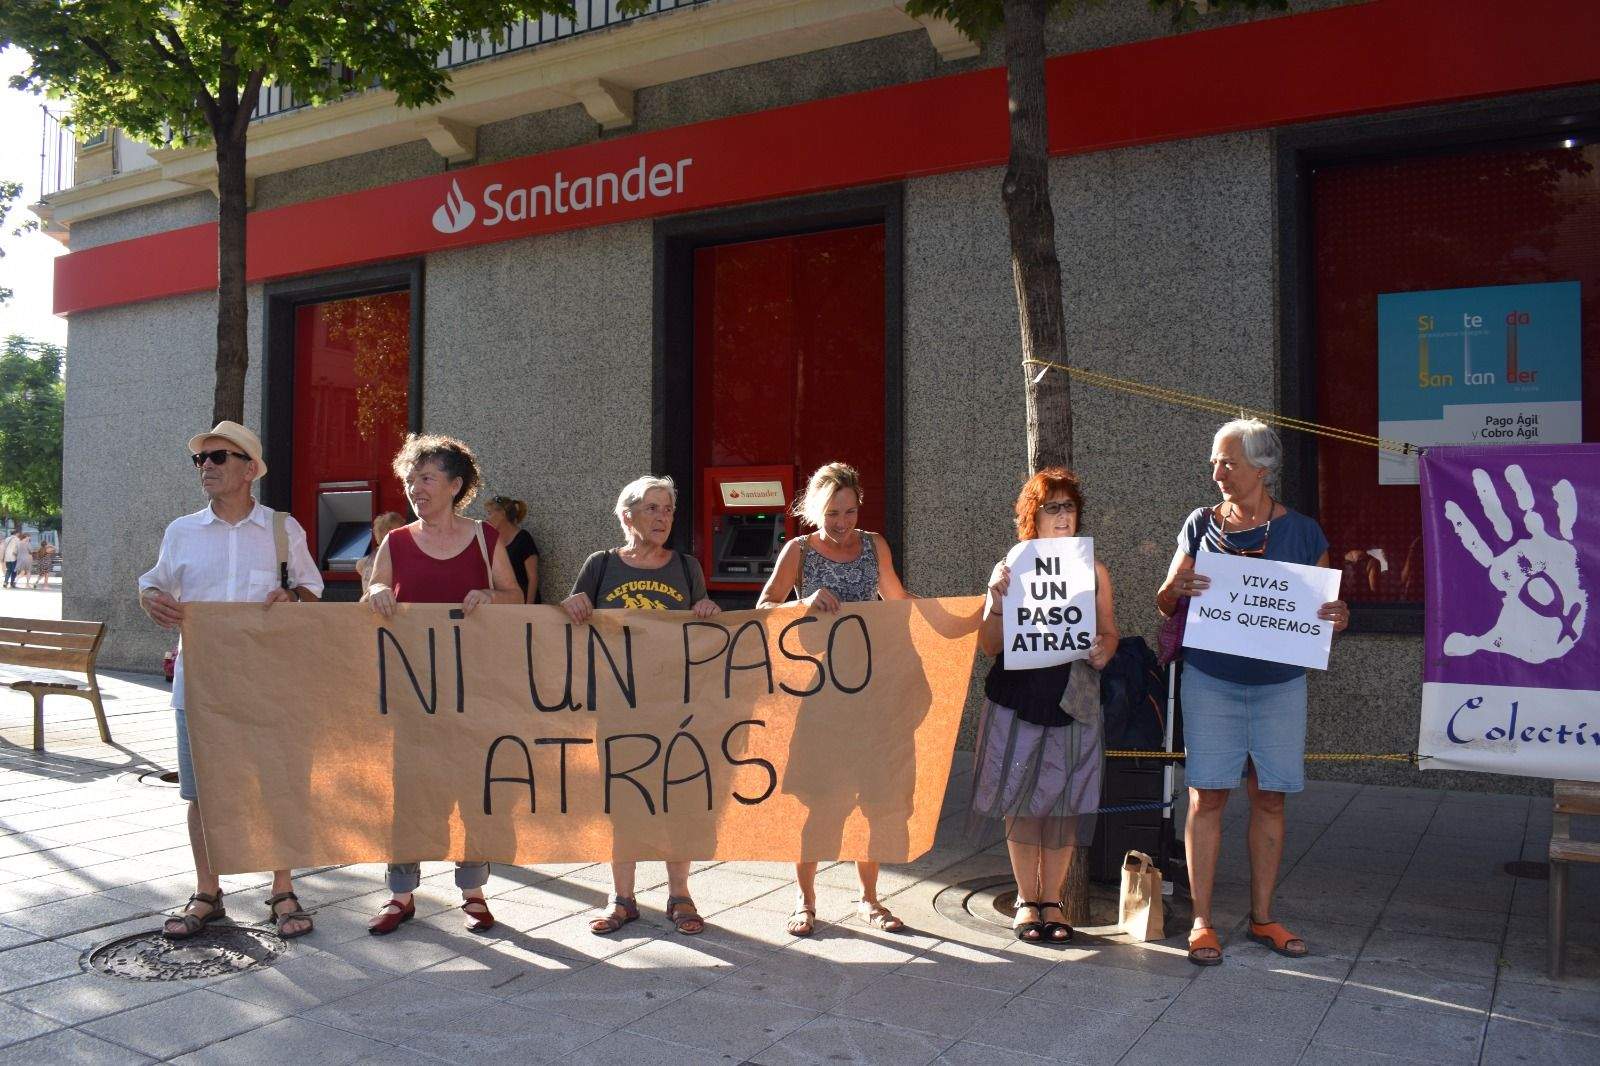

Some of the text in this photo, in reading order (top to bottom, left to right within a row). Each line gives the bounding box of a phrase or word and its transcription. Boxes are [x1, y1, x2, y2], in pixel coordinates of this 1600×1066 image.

[482, 156, 693, 226] Santander
[1418, 311, 1530, 331] Si te da
[1418, 367, 1538, 388] San tan der
[1485, 412, 1539, 428] Pago Ágil
[1481, 428, 1514, 438] Cobro
[1516, 425, 1539, 440] Ágil
[740, 489, 777, 499] Santander
[1034, 556, 1061, 576] NI
[1030, 581, 1068, 601] UN
[1242, 574, 1290, 592] VIVAS
[1229, 591, 1296, 612] Y LIBRES
[1017, 605, 1083, 626] PASO
[1199, 605, 1321, 636] NOS QUEREMOS
[1011, 626, 1092, 652] ATRÁS
[682, 614, 873, 704] PASO
[483, 714, 778, 816] ATRÁS
